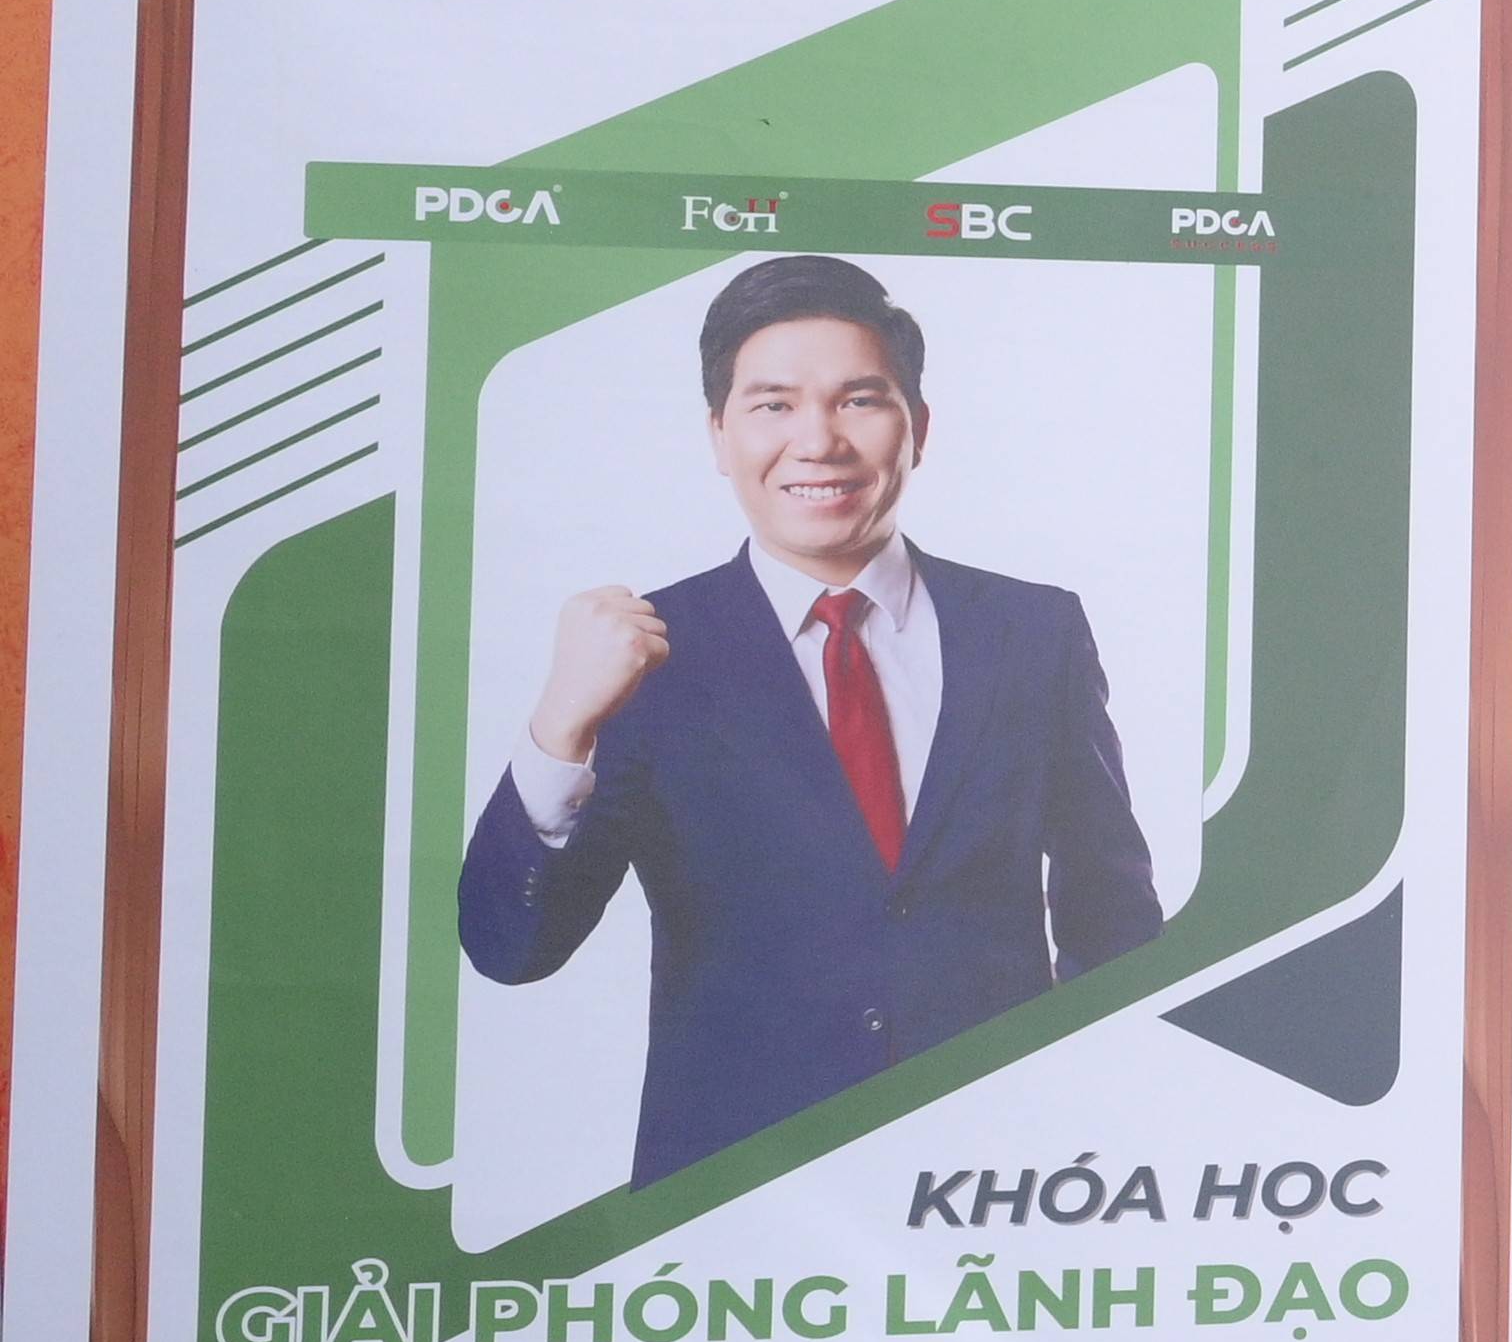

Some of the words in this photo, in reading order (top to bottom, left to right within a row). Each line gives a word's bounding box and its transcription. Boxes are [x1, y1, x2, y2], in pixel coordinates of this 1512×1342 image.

[925, 202, 1032, 240] SBC
[907, 1152, 1166, 1230] KHÓA
[1193, 1159, 1390, 1234] HỌC
[885, 1253, 1156, 1336] LÃNH
[1187, 1258, 1410, 1340] ĐẠO
